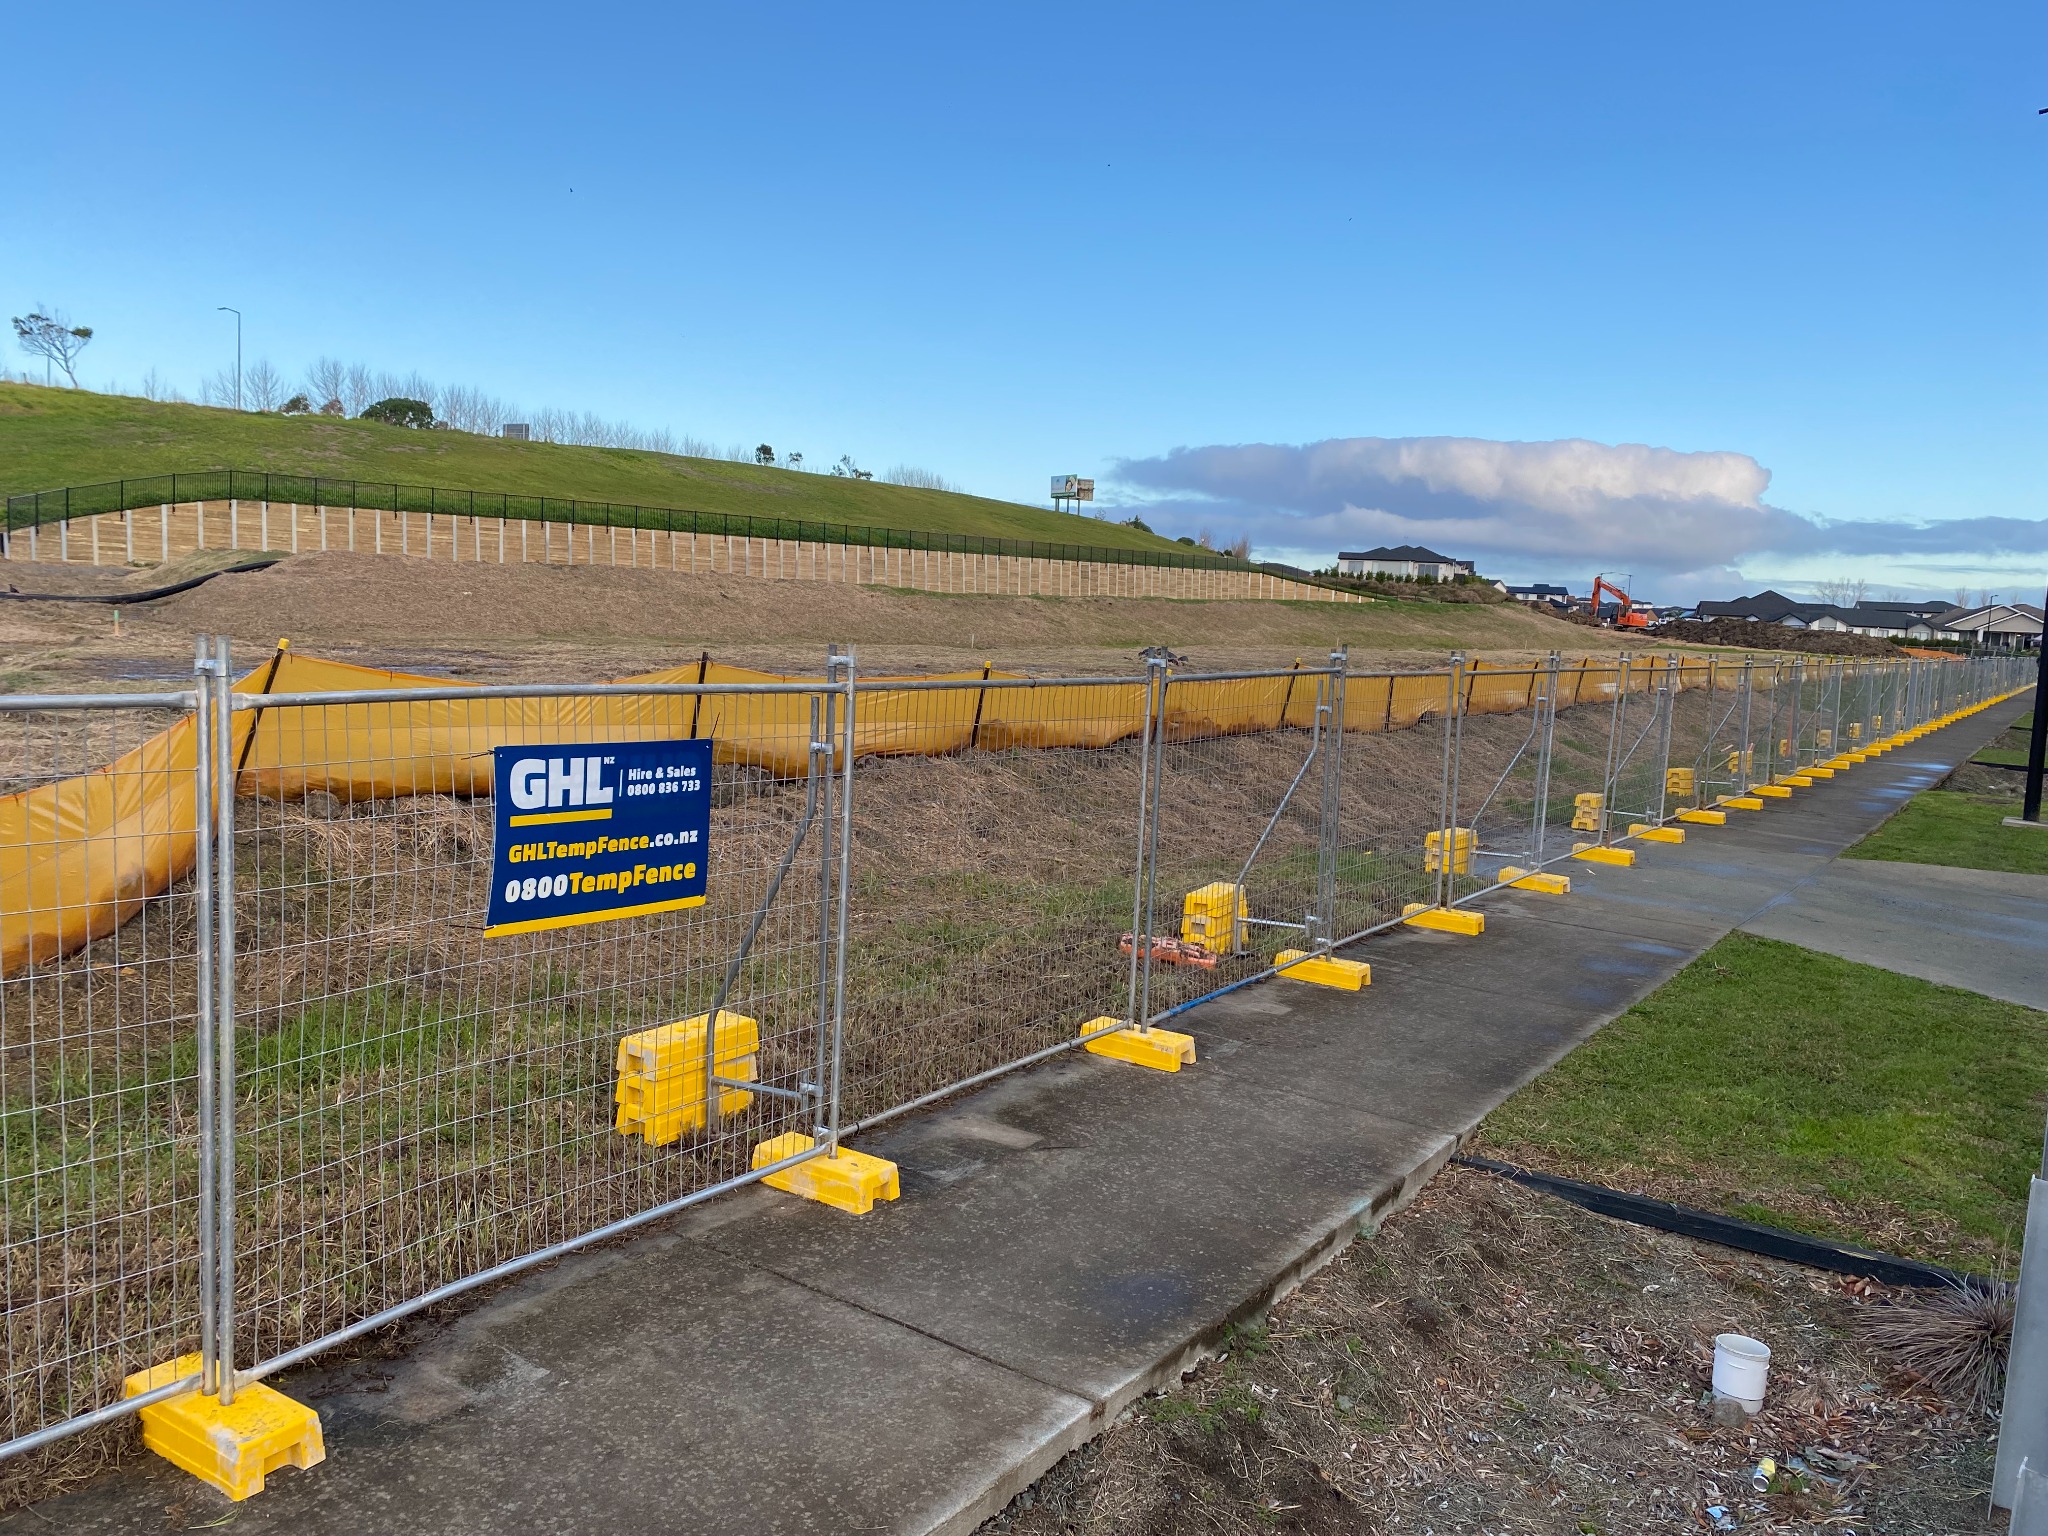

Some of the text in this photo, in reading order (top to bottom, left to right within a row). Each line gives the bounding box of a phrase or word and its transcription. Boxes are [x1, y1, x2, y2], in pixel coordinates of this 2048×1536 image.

[510, 756, 614, 810] GHL
[627, 779, 700, 796] 0800 836 733
[628, 766, 696, 781] Hire & Sales
[508, 830, 698, 863] GHLTempFence.co.nz
[505, 862, 696, 903] 0800TempFence
